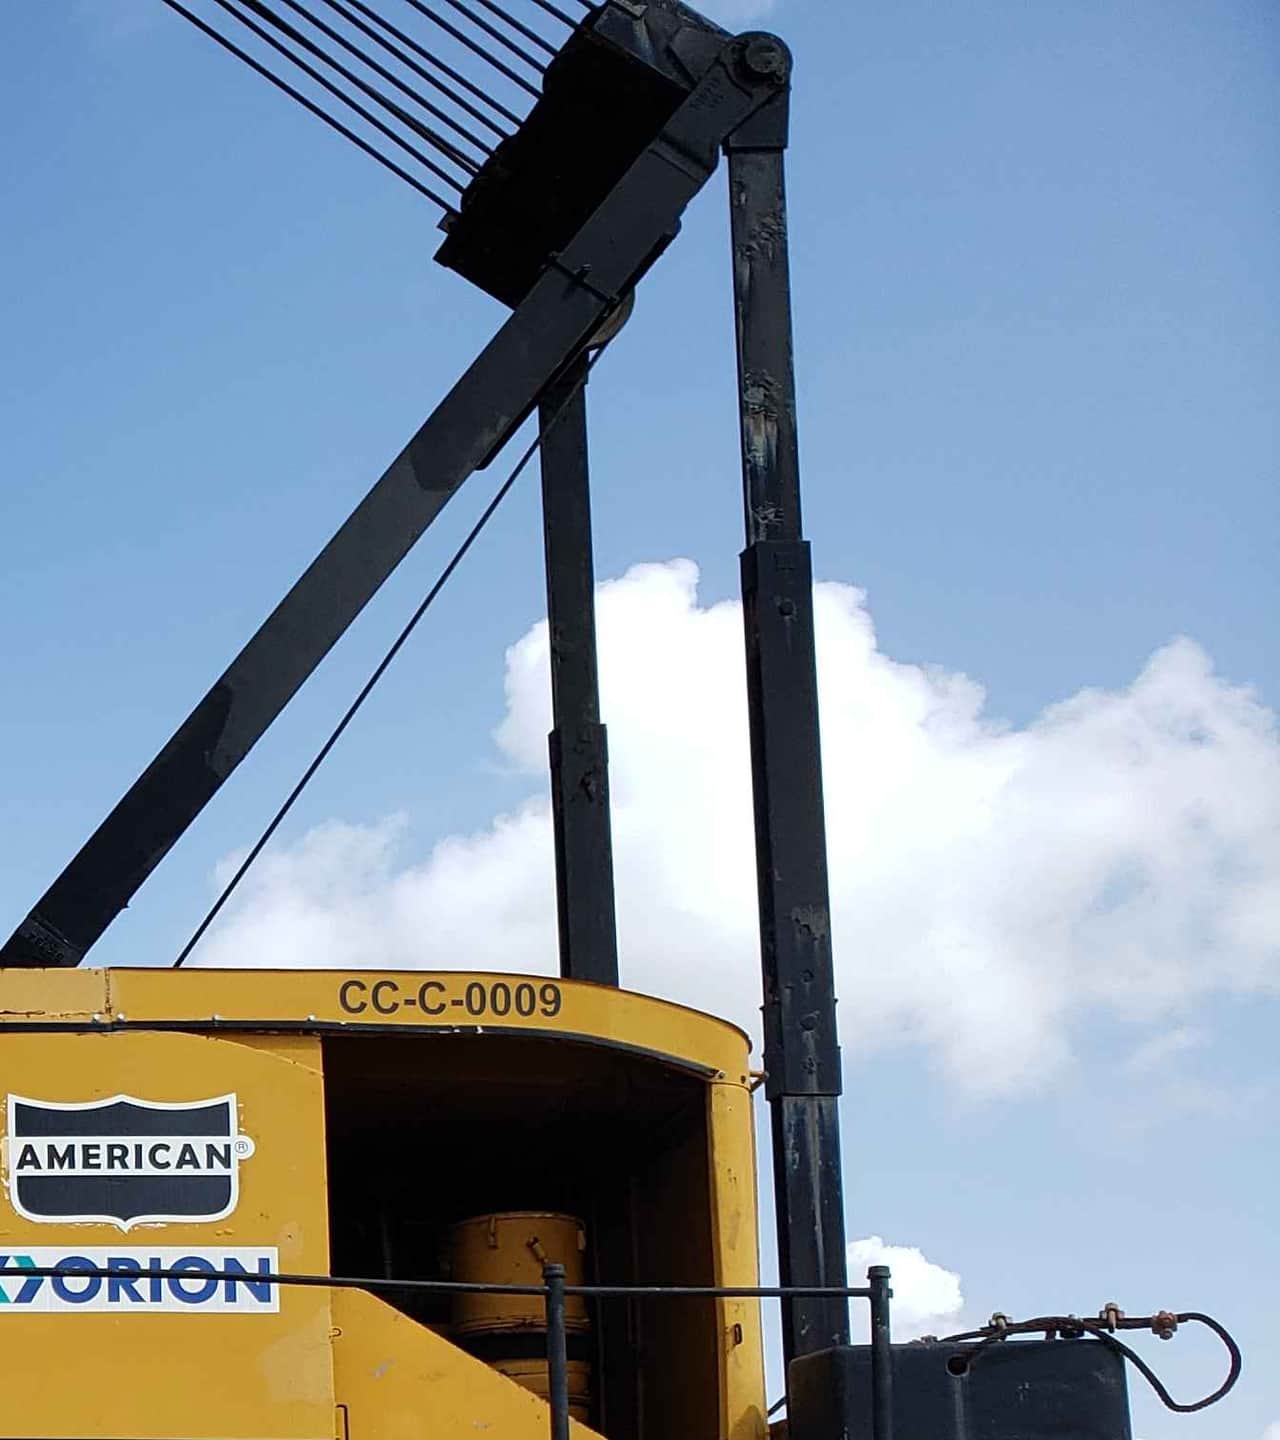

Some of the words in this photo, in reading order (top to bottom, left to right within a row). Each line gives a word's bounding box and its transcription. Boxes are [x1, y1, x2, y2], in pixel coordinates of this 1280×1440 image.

[340, 979, 562, 1017] CC-C-0009
[16, 1143, 232, 1170] AMERICAN
[51, 1255, 272, 1304] ORION
